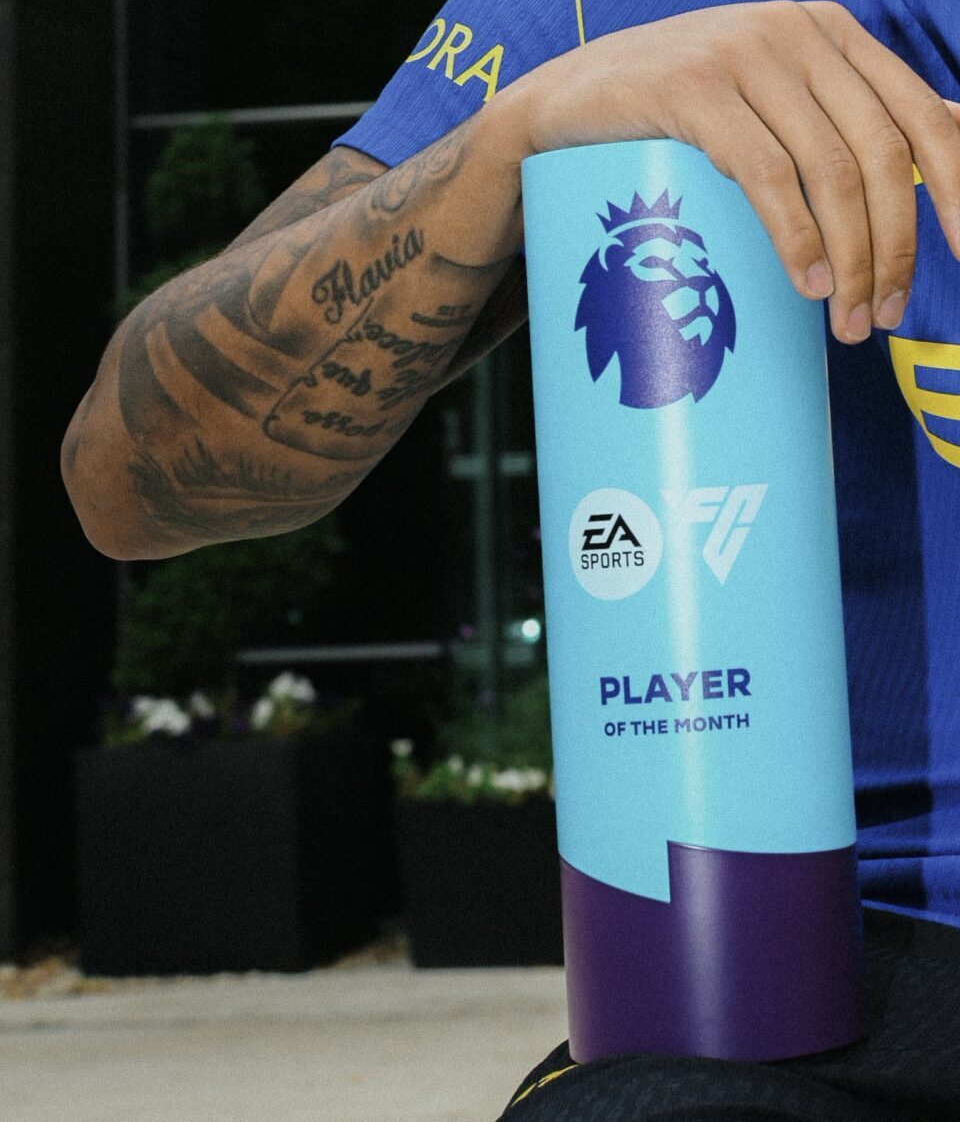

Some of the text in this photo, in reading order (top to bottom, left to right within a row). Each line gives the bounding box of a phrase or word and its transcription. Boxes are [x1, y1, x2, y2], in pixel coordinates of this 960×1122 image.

[311, 226, 424, 324] Flavia
[581, 513, 642, 551] EA
[662, 484, 769, 586] FC
[580, 550, 645, 570] SPORTS
[599, 667, 752, 706] PLAYER
[603, 712, 750, 737] OF THE MONTH
